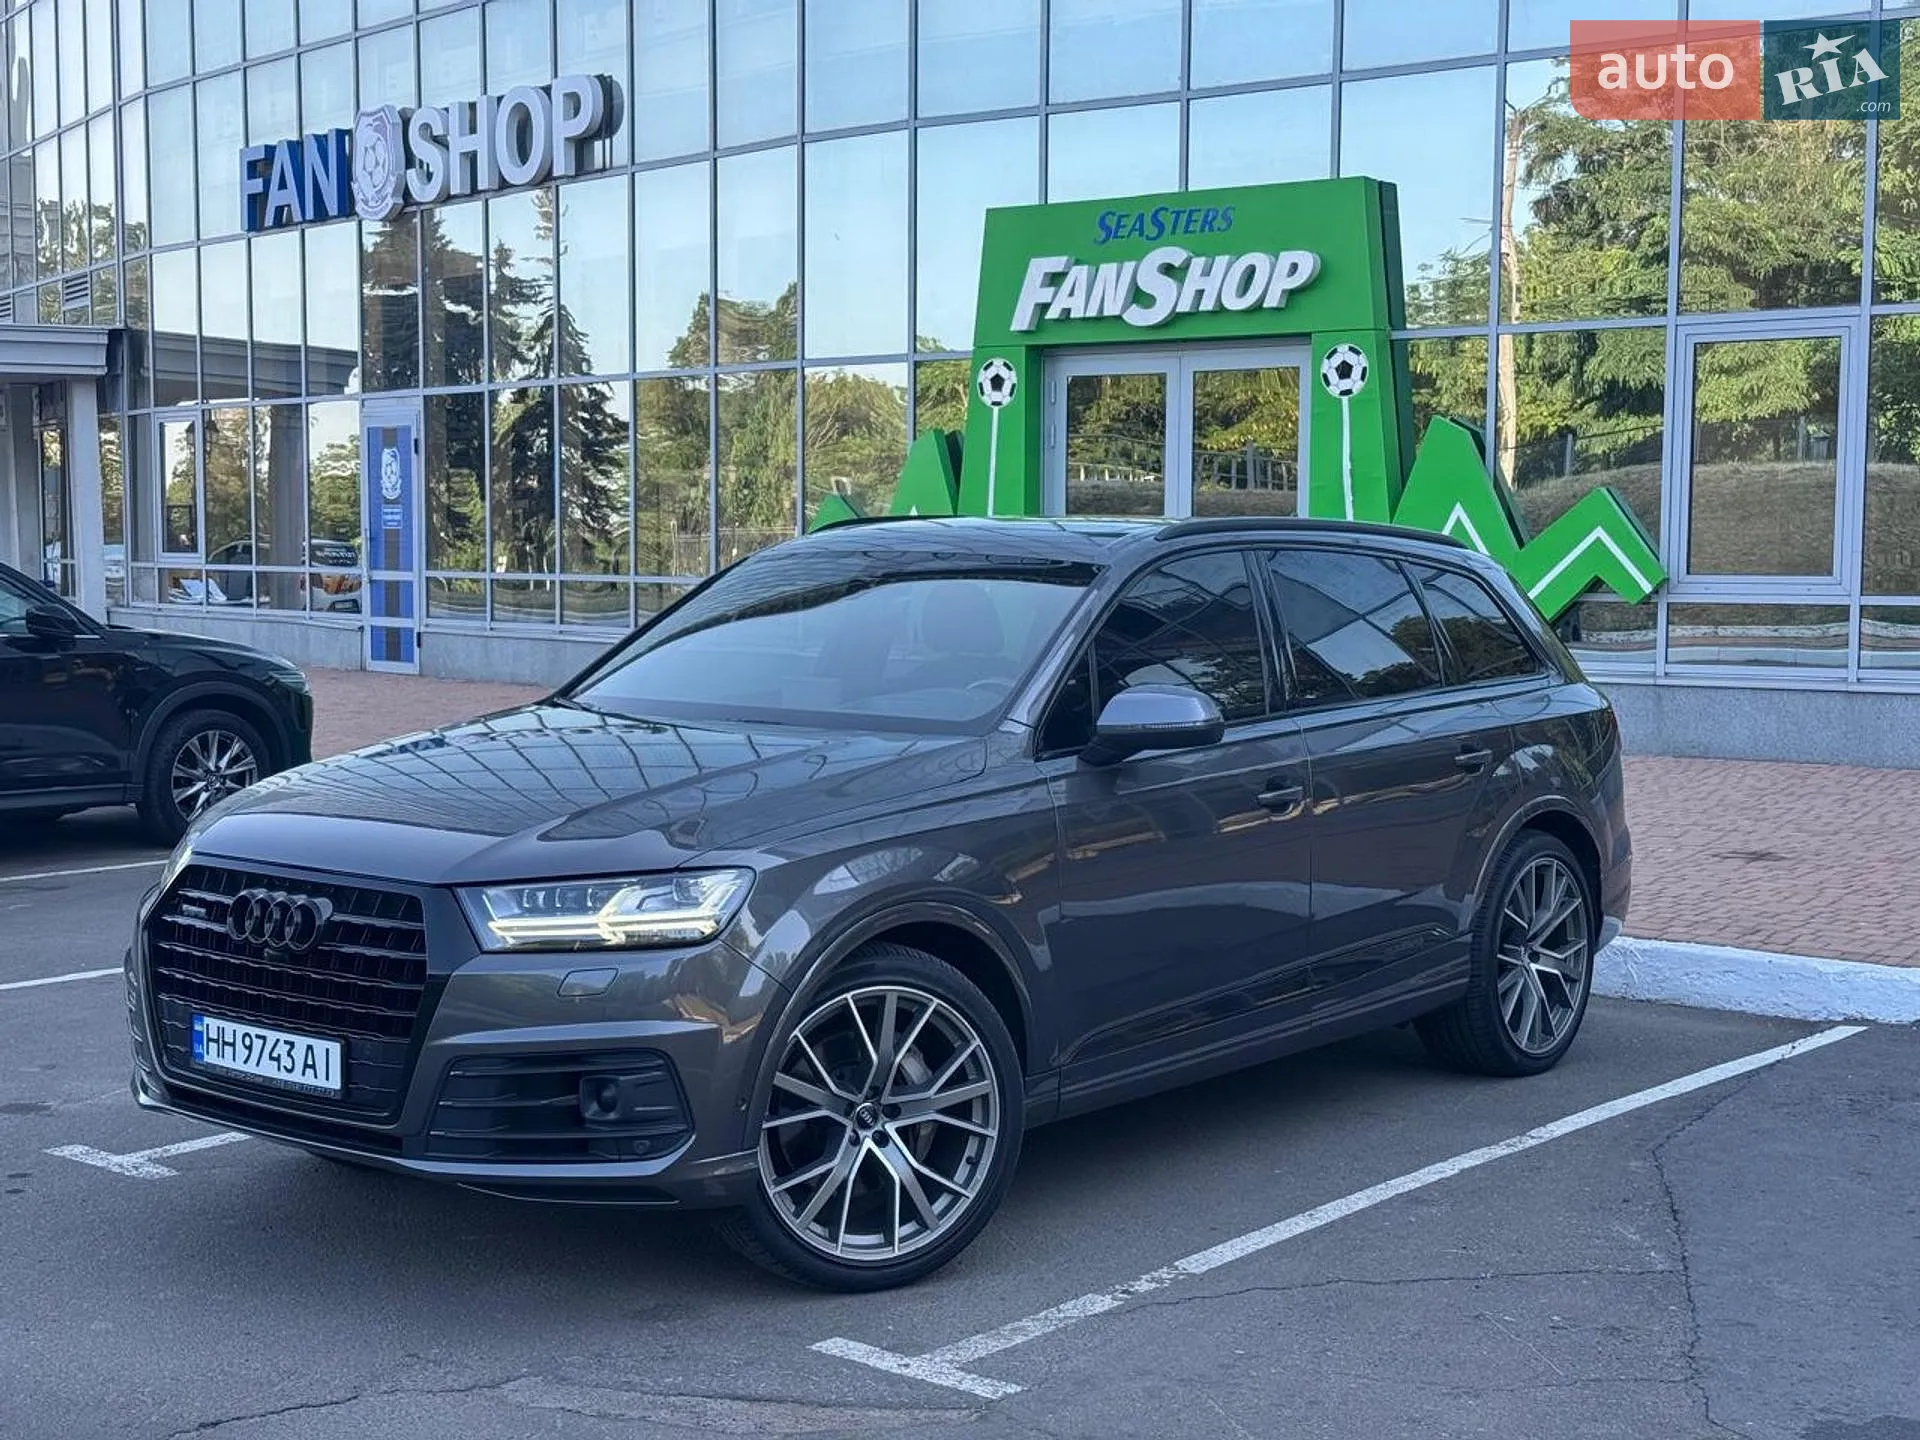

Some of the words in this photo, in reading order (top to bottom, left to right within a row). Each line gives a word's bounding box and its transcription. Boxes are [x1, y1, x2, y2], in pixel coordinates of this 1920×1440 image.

[240, 127, 347, 232] FAN
[406, 74, 604, 203] SHOP
[1094, 206, 1236, 245] SEASTERS
